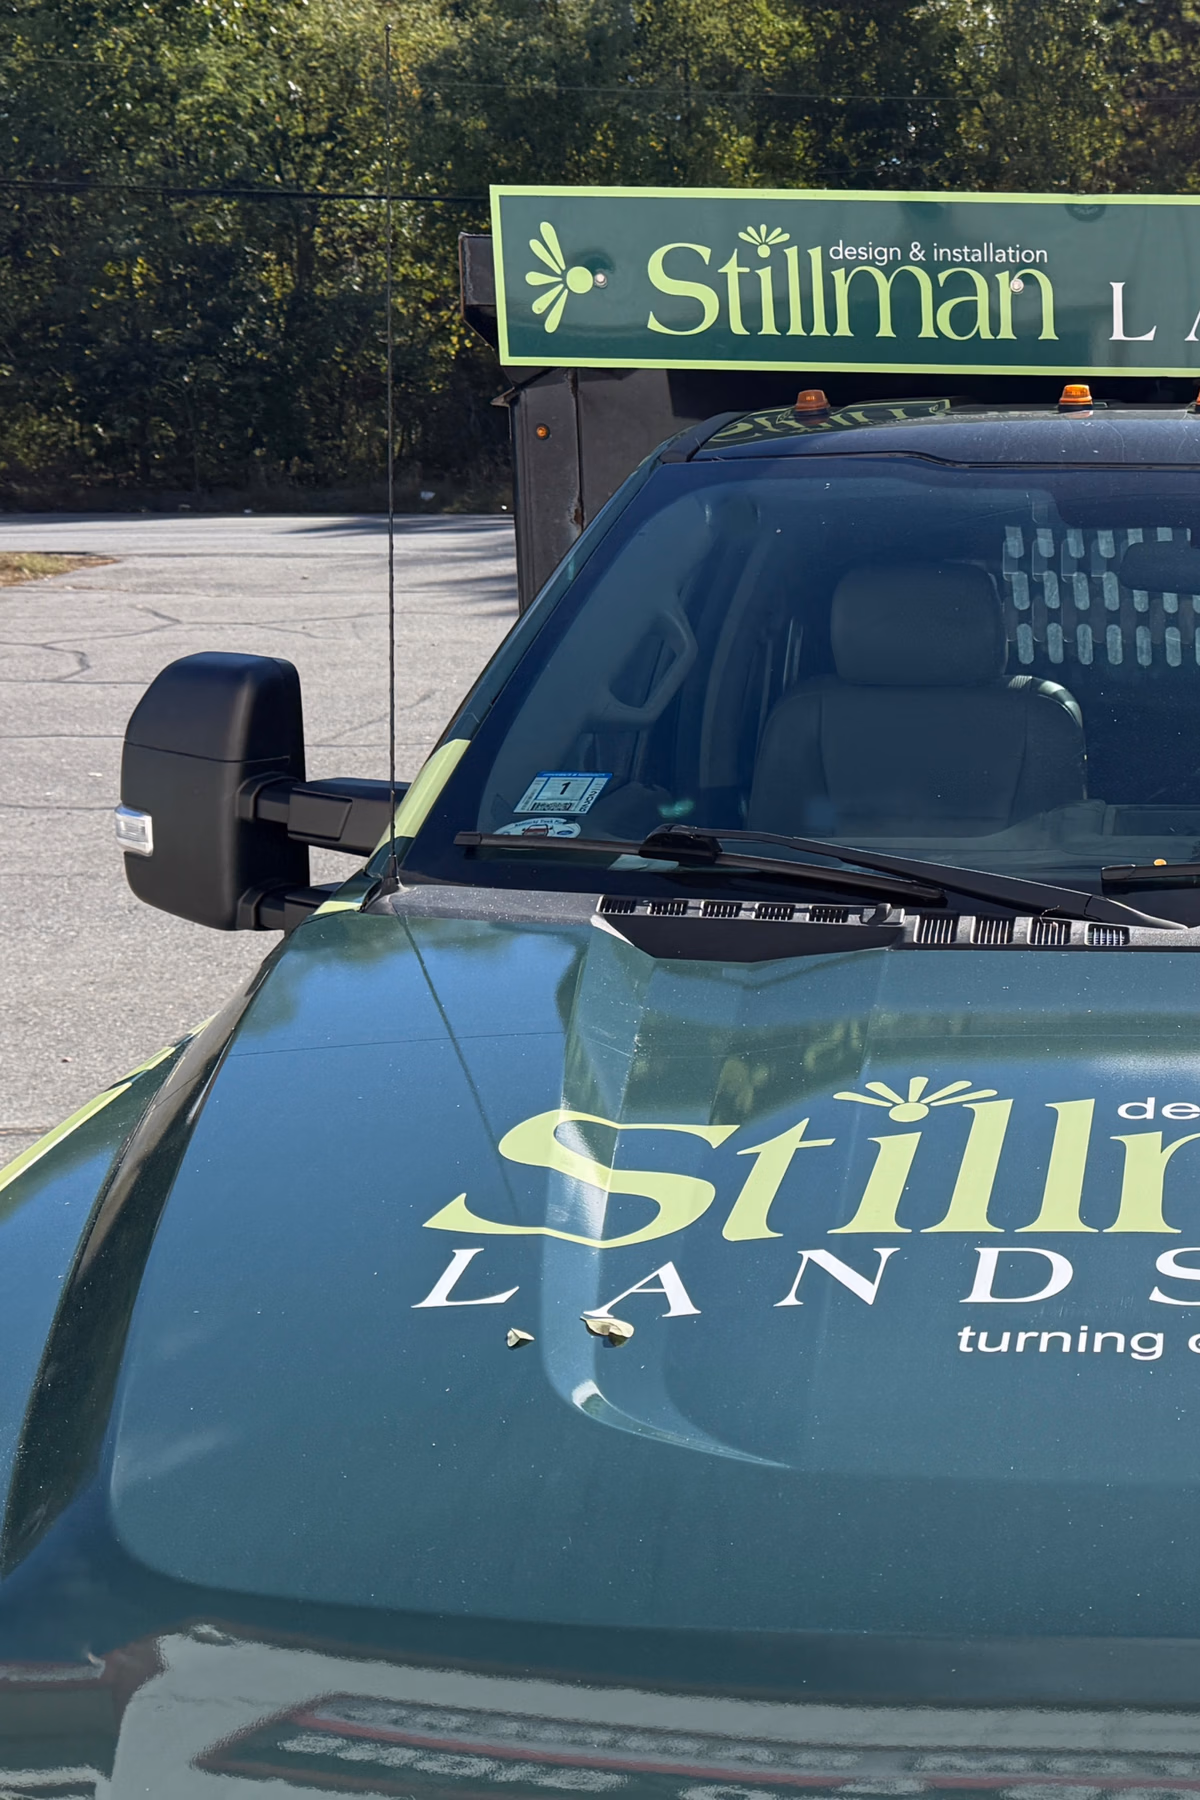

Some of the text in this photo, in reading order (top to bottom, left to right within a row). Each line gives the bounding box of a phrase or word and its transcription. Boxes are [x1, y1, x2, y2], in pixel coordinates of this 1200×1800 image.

[829, 240, 1048, 266] design & installation
[647, 242, 1059, 341] Stillman
[560, 781, 571, 795] 1
[957, 1325, 1165, 1361] turning
